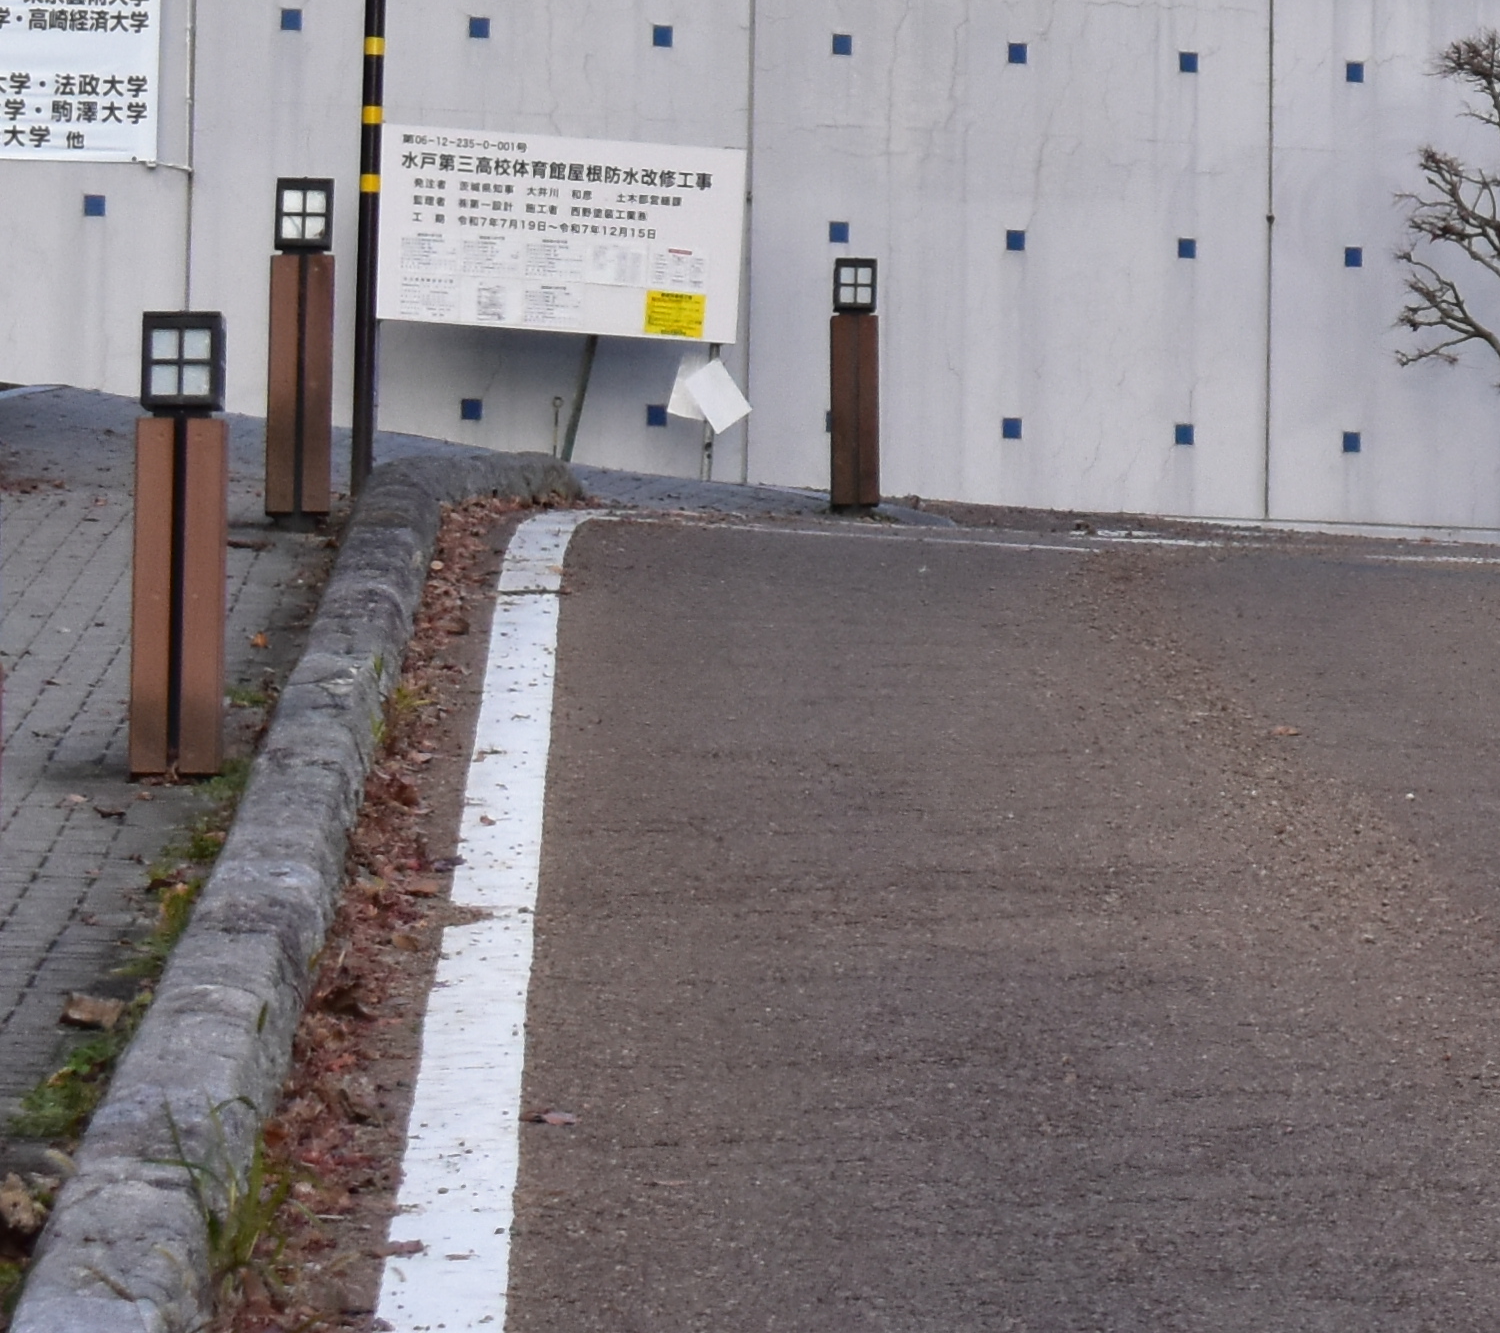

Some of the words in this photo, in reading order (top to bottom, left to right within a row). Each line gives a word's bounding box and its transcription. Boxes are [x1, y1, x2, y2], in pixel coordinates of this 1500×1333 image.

[4, 125, 51, 148] 大学
[66, 131, 85, 149] 他
[401, 151, 714, 191] 水戸第三高校体育館屋根防水改修工事
[526, 186, 560, 198] 大井川
